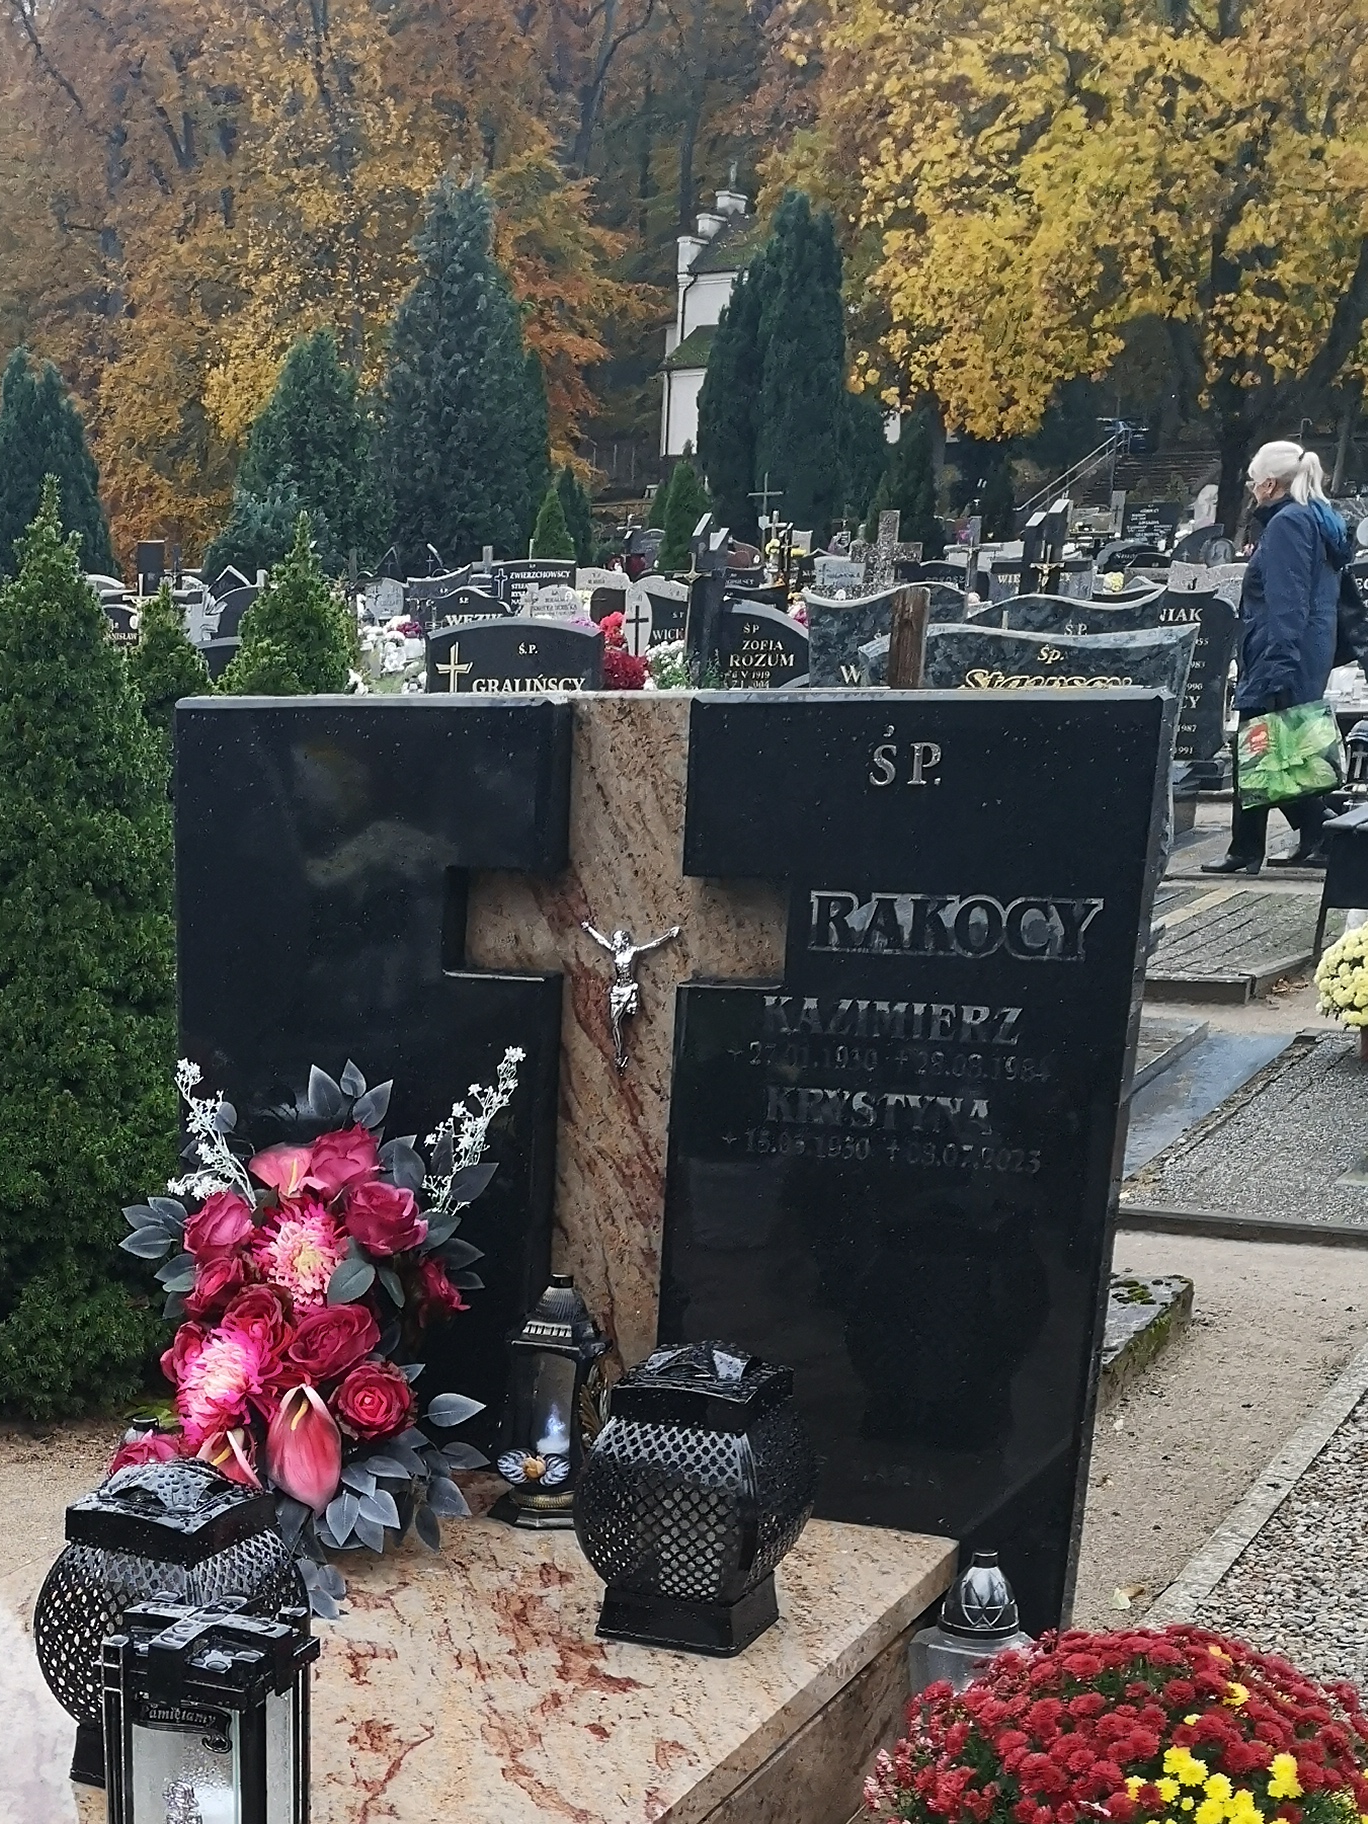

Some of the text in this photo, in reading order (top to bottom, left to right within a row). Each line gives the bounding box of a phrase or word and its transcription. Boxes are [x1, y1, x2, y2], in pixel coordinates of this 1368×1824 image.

[742, 639, 784, 651] ZOFIA
[729, 653, 795, 667] ROZUM
[472, 673, 586, 692] GRALIŃSCY
[808, 890, 1105, 960] RAKOCY
[763, 995, 1023, 1045] KAZIMIERZ
[764, 1084, 993, 1136] KRYSTYNA
[141, 1702, 216, 1729] Pamiętamy
